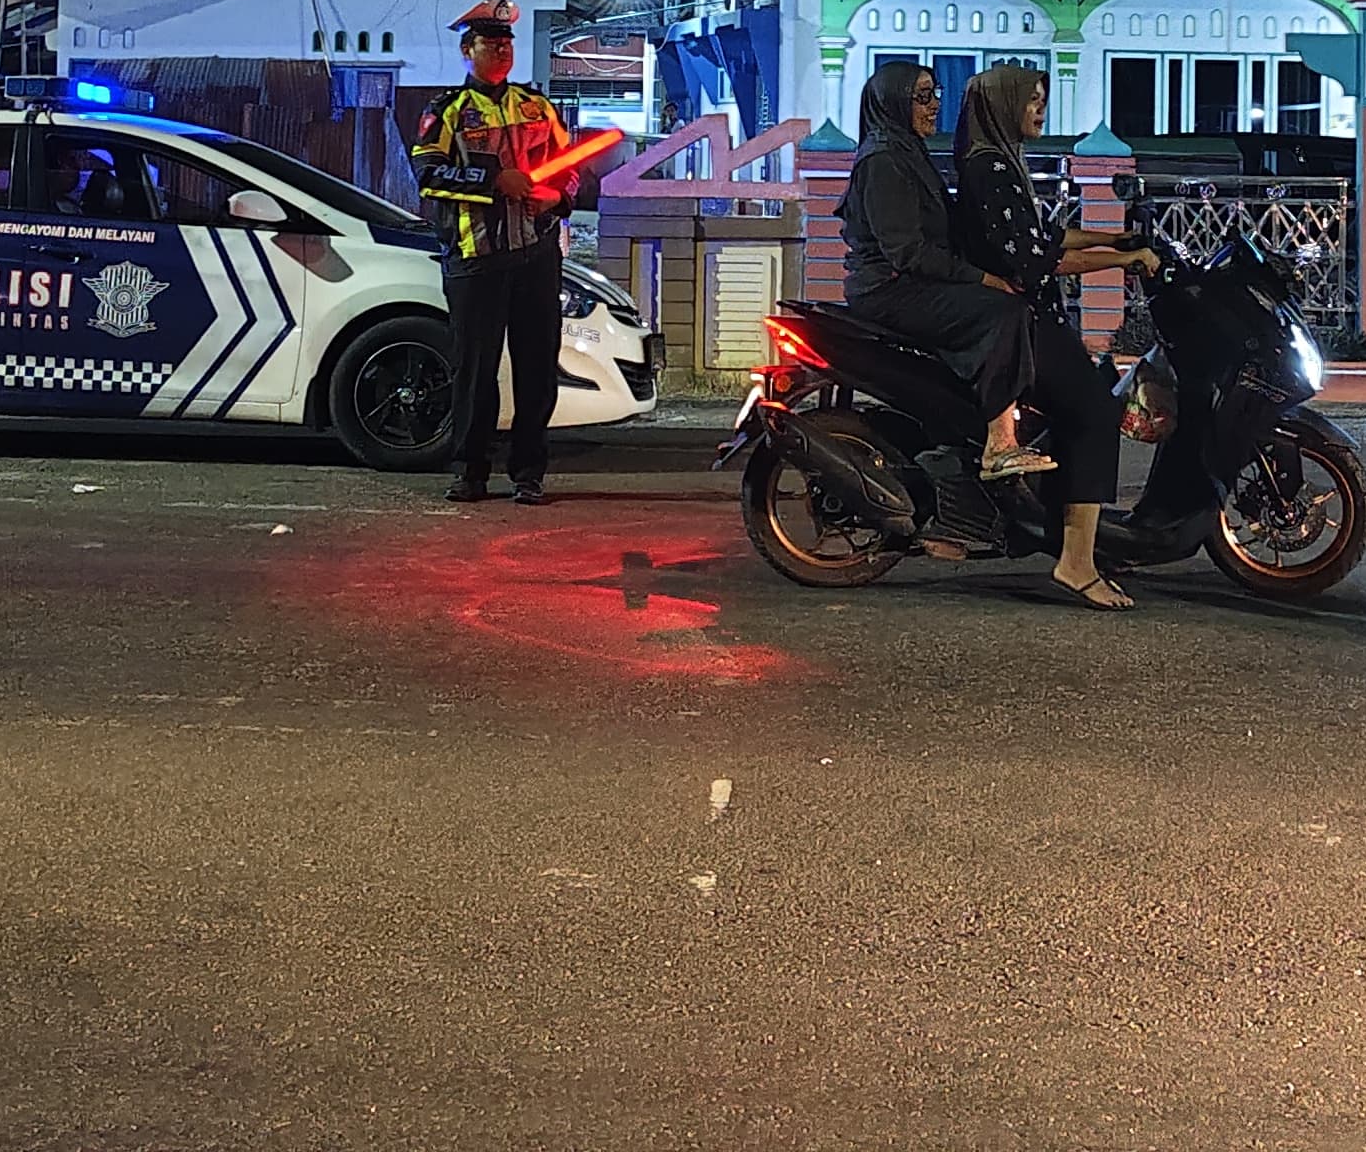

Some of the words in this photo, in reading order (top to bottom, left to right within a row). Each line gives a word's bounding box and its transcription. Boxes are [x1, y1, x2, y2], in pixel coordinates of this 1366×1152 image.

[433, 164, 486, 182] POLISI
[68, 228, 93, 239] DAN
[95, 229, 155, 243] MELAYANI
